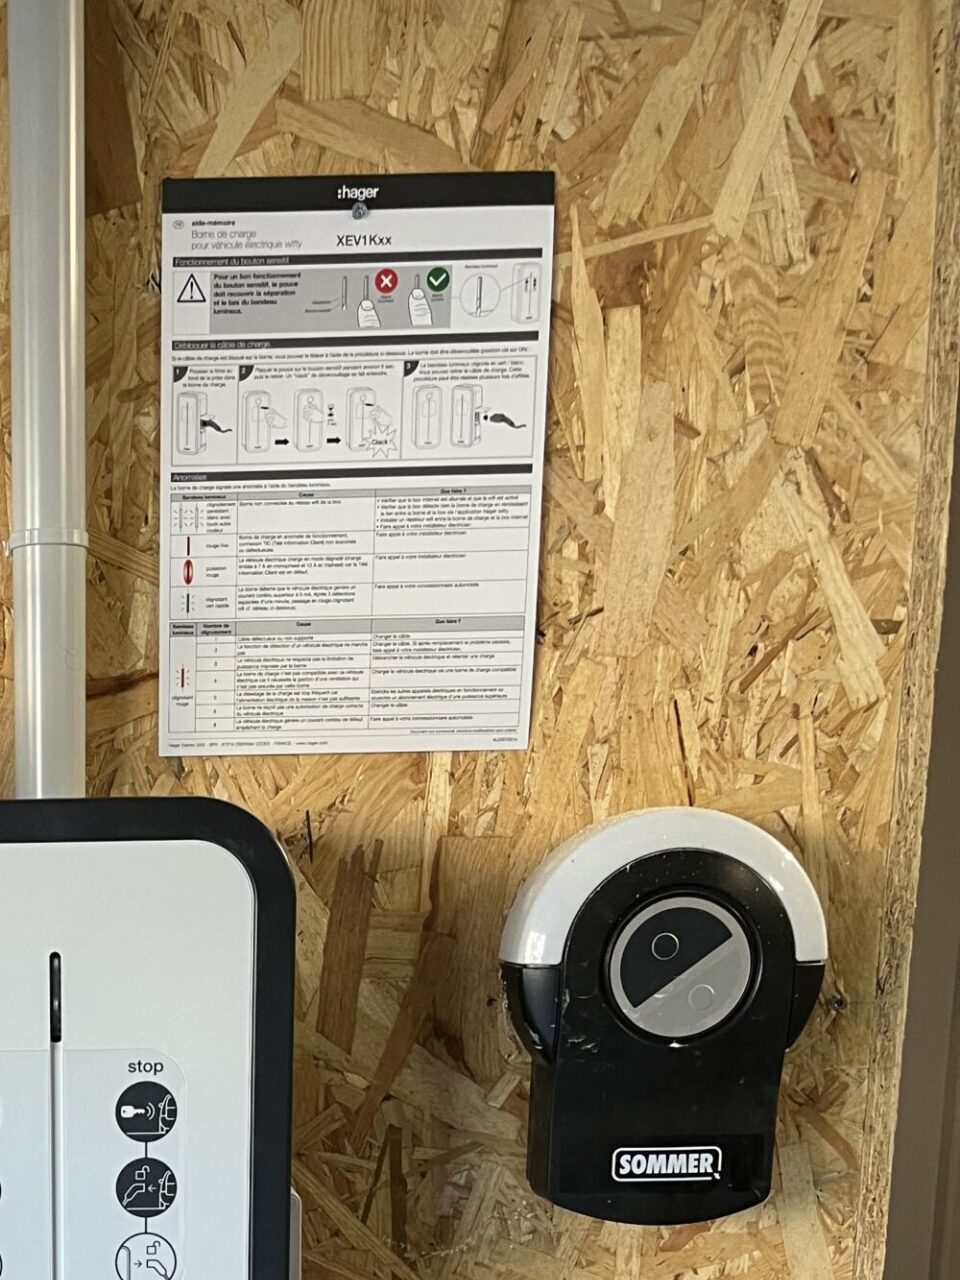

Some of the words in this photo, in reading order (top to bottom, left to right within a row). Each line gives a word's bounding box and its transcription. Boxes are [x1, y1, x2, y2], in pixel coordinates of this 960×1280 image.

[217, 229, 228, 239] de
[229, 229, 257, 242] charge
[337, 233, 392, 247] XEV1Kxx
[192, 242, 209, 250] pour
[127, 1059, 164, 1075] stop
[619, 1153, 714, 1175] SOMMER
